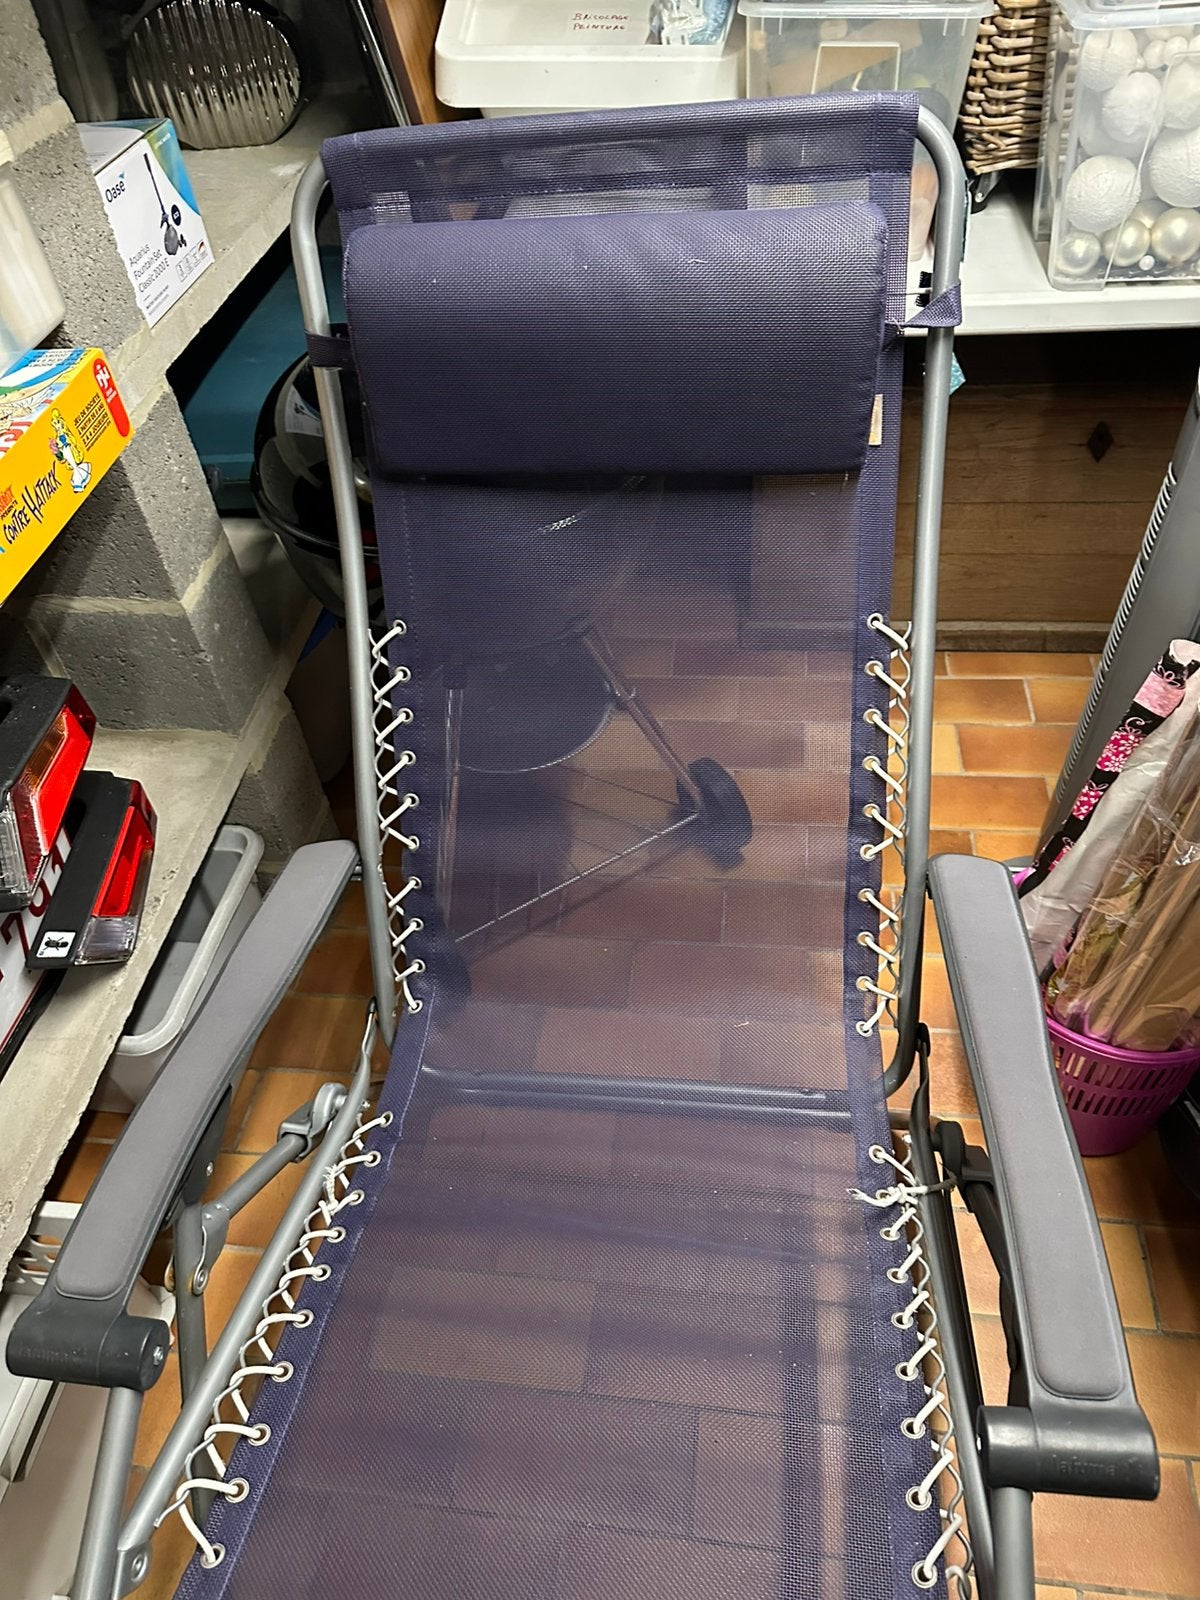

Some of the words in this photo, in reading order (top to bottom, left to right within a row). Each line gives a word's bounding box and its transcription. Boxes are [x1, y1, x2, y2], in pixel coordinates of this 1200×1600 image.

[572, 12, 629, 21] BRICOLAGE
[573, 22, 626, 31] PEINTURE
[105, 181, 126, 203] Oase
[129, 244, 150, 267] Aquarius
[134, 257, 154, 280] Fountain
[153, 249, 162, 261] Set
[138, 273, 155, 292] Classic
[21, 460, 62, 524] HATTACK
